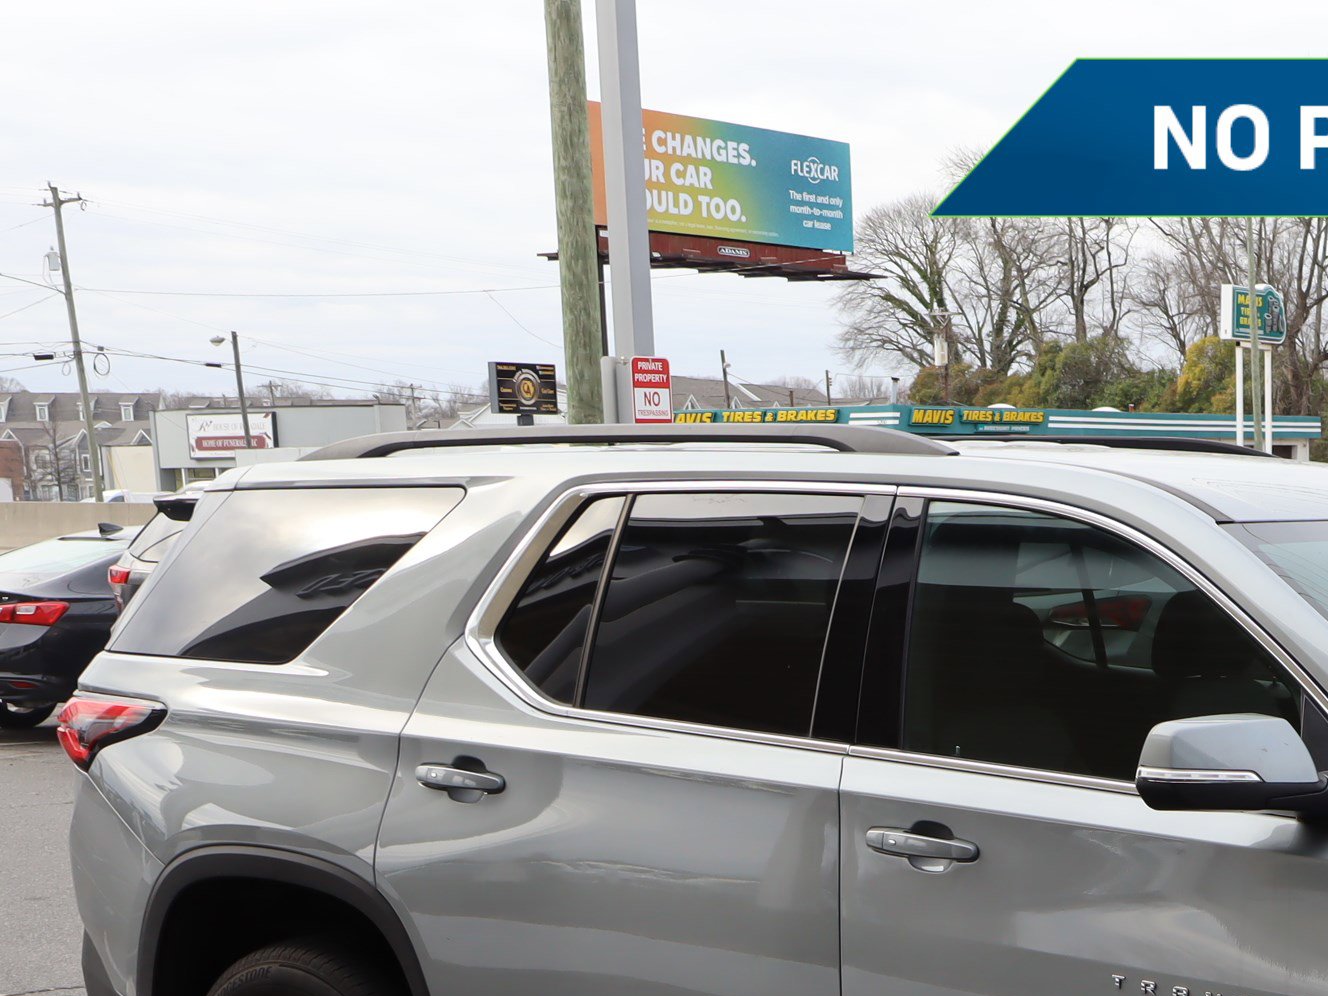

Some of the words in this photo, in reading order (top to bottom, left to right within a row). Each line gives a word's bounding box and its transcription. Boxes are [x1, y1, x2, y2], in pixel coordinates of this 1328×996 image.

[651, 129, 757, 167] CHANGES.
[670, 162, 713, 190] CAR
[791, 158, 839, 182] FLEXCAR
[789, 190, 802, 201] The
[803, 192, 816, 203] first
[817, 195, 829, 204] and
[829, 197, 843, 208] only
[698, 194, 747, 222] TOO.
[790, 205, 843, 219] month-to-month
[803, 220, 814, 228] car
[815, 220, 832, 230] lease
[720, 248, 748, 256] ADAMS
[637, 361, 664, 371] PRIVATE
[635, 373, 668, 383] PROPERTY
[643, 391, 661, 407] NO
[637, 409, 669, 417] TRESPASSING
[674, 412, 713, 424] AVIS
[722, 411, 763, 423] TIRES
[765, 411, 774, 422] &
[777, 409, 836, 422] BRAKES
[912, 409, 955, 424] MAVIS
[962, 410, 993, 422] TIRES
[994, 412, 1002, 422] &
[1002, 411, 1044, 423] BRAKES
